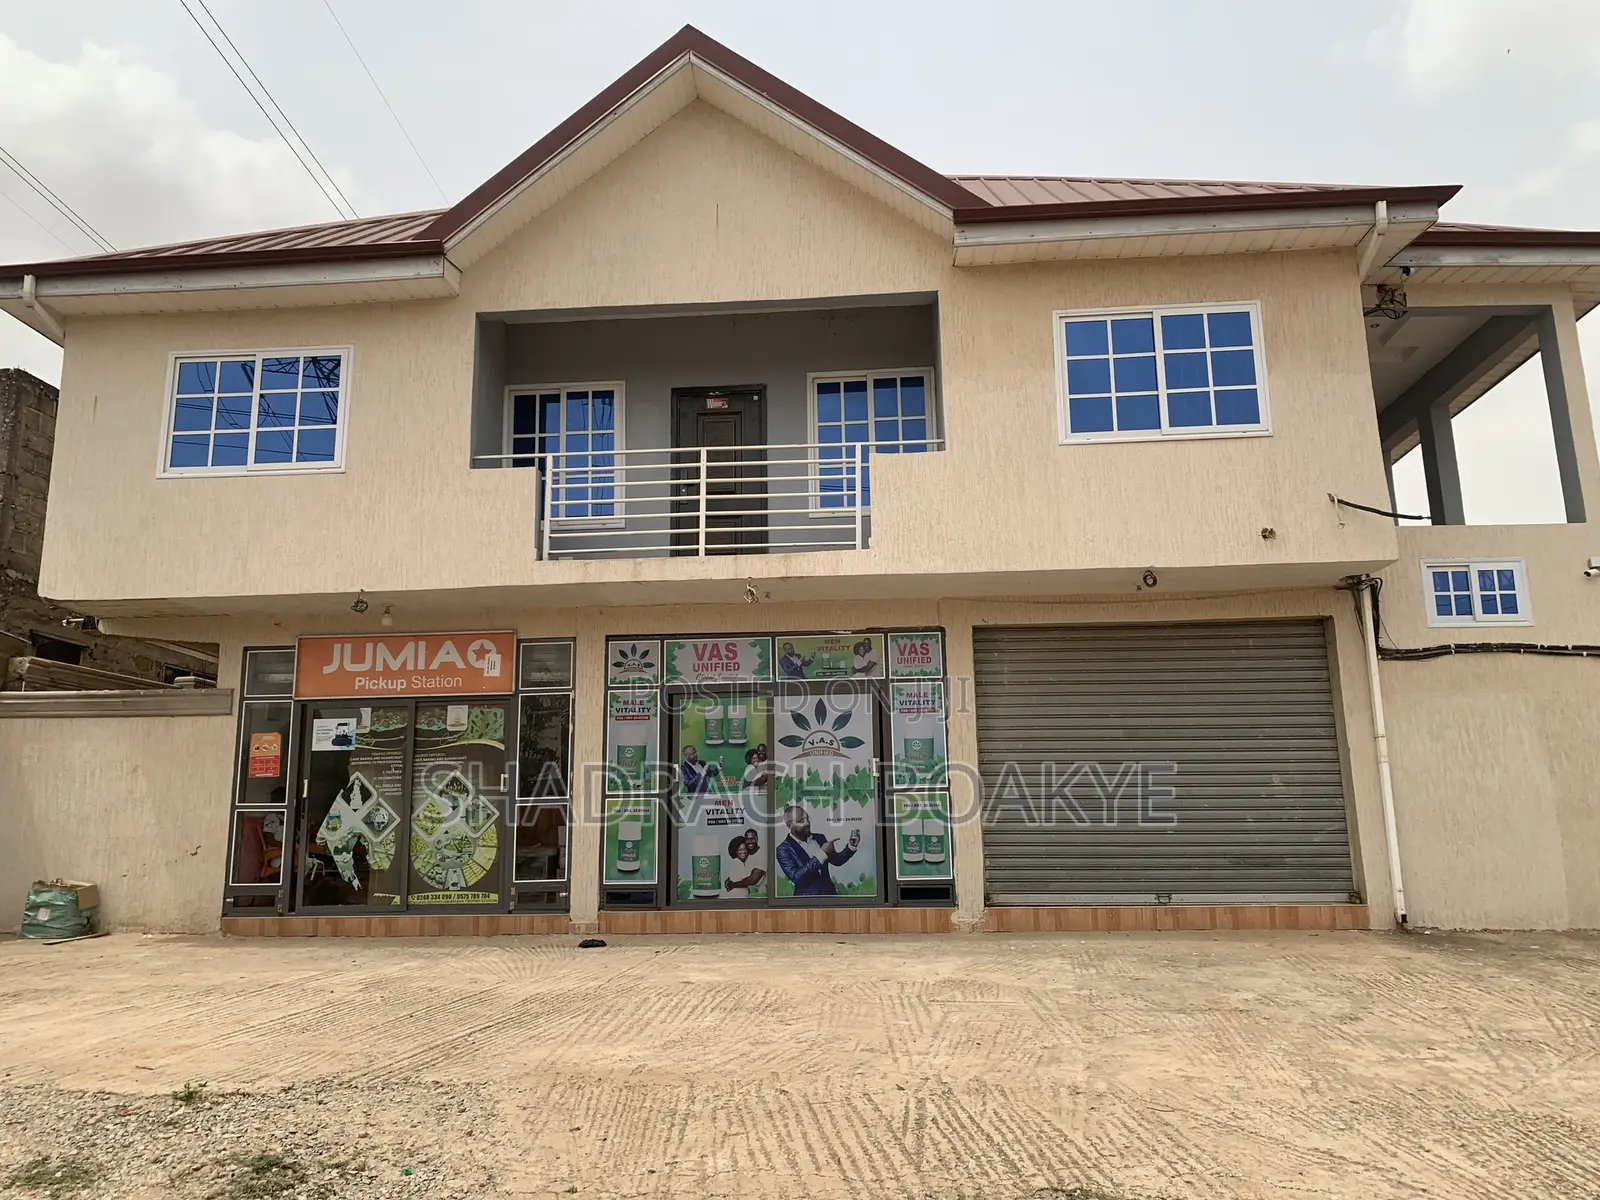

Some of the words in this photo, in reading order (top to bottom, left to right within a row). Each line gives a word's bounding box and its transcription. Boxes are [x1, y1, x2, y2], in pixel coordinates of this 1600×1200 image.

[693, 642, 738, 661] VAS
[896, 643, 930, 656] VAS
[323, 640, 466, 674] JUMIA
[897, 657, 932, 665] UNIFIED
[693, 662, 740, 672] UNIFIED
[355, 677, 406, 691] Pickup
[411, 675, 462, 688] Station
[808, 737, 835, 746] V.A.S
